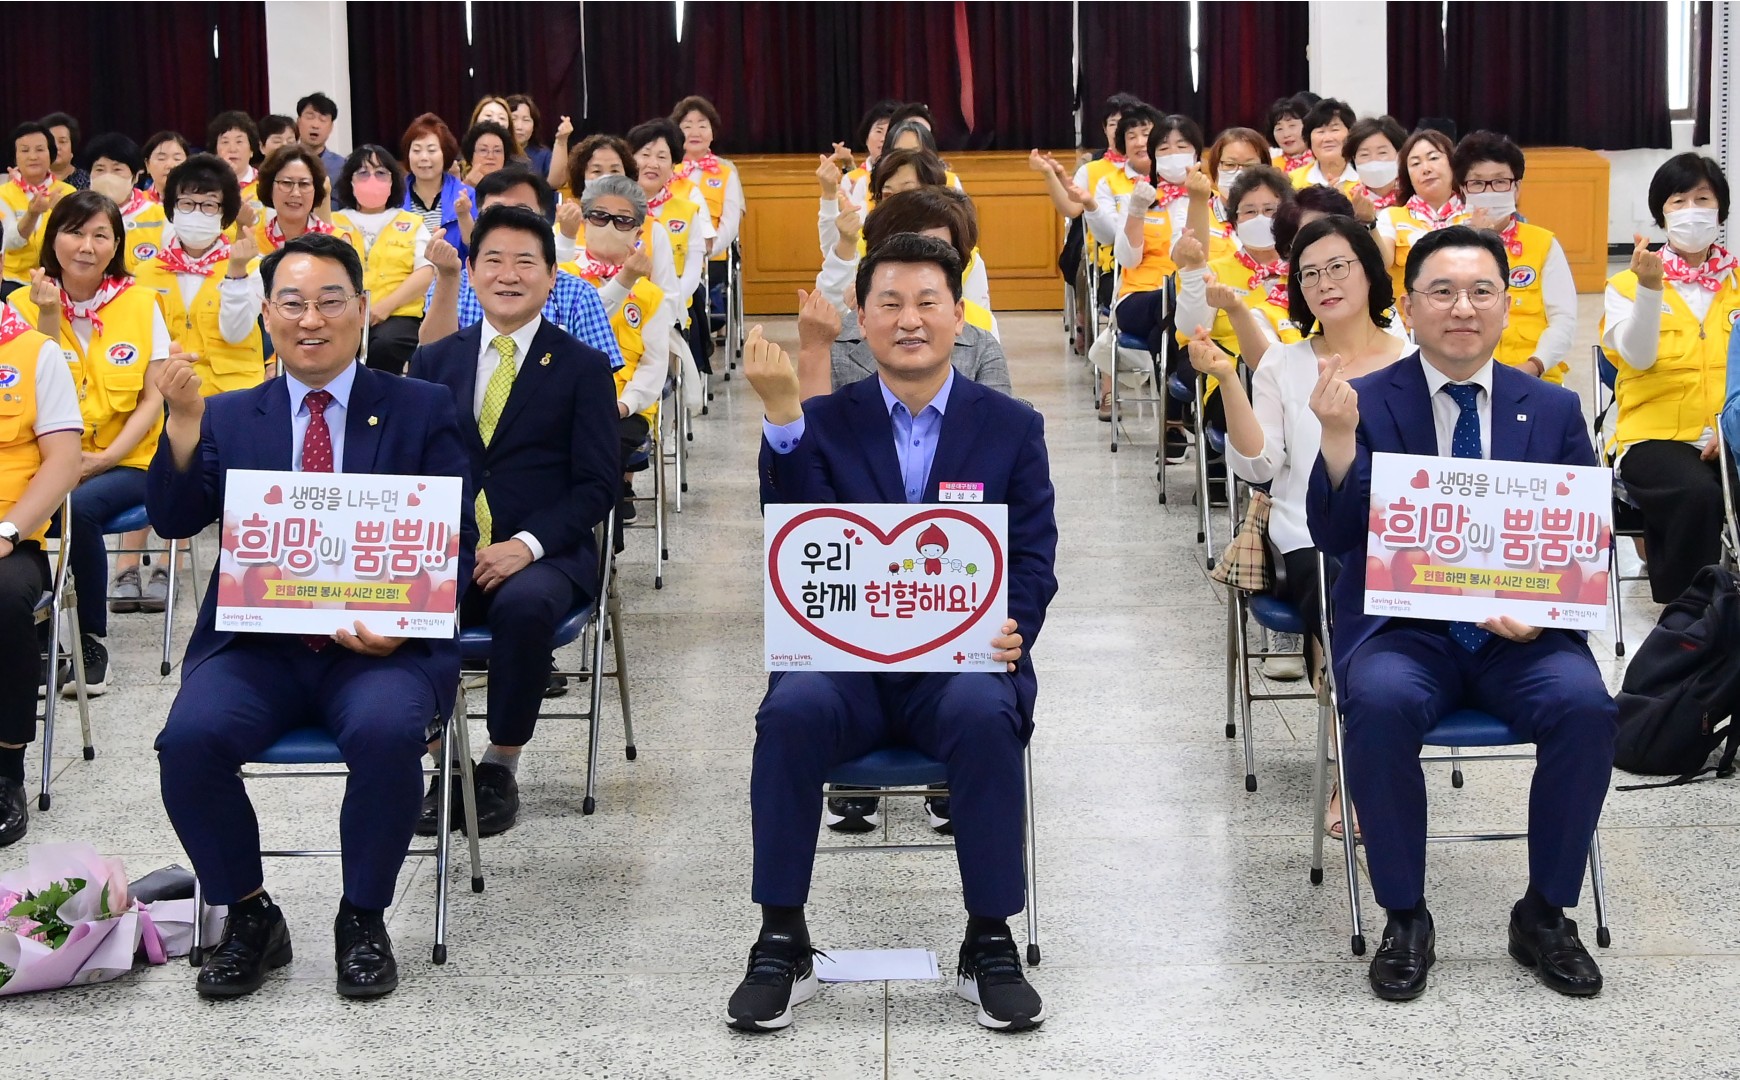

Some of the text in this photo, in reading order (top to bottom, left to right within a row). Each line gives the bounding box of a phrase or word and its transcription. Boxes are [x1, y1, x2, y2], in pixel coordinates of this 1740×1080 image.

[289, 486, 399, 513] 생명을 나누면
[1436, 471, 1547, 501] 생명을 나누면
[235, 512, 445, 573] 희망이 뿜뿜!!
[1383, 496, 1595, 563] 희망이 뿜뿜!!
[801, 542, 851, 574] 우리
[275, 584, 400, 599] 헌혈하면 봉사 4시간 인정!
[1423, 570, 1550, 589] 헌혈하면 봉사 4시간 인정!
[801, 580, 978, 619] 함께 헌혈해요!
[1371, 597, 1393, 605] Saving
[222, 613, 244, 621] Saving
[967, 652, 992, 660] 대한적십
